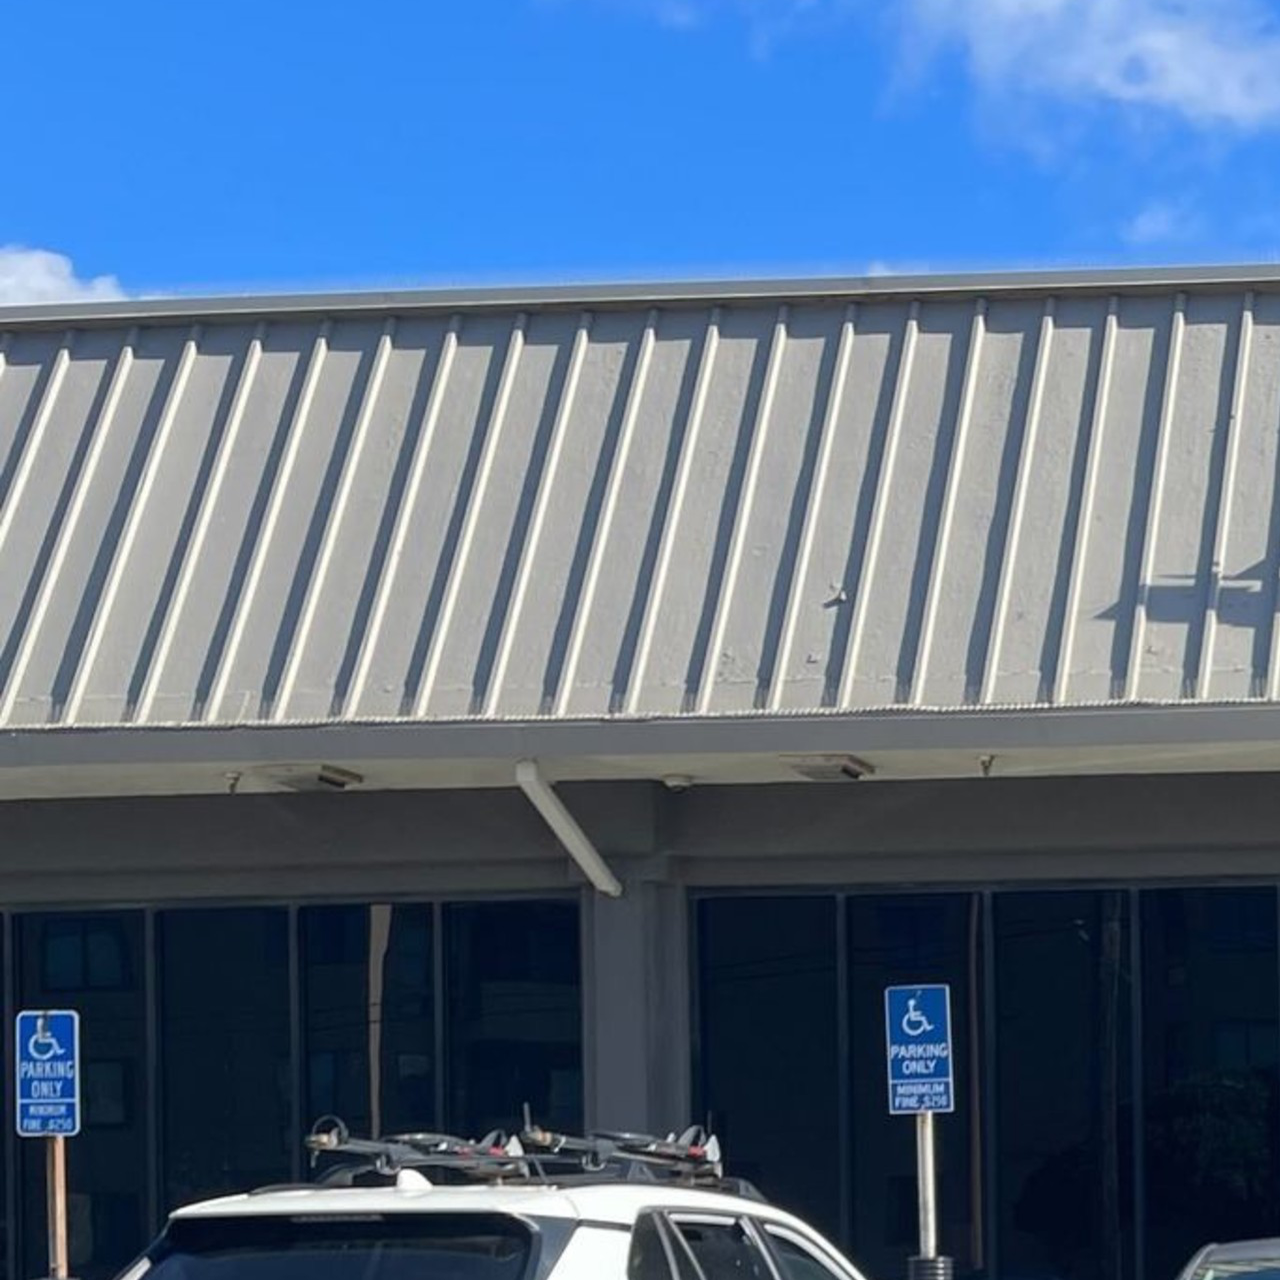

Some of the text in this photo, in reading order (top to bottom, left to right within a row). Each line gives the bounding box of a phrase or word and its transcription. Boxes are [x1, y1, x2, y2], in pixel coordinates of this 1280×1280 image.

[890, 1042, 948, 1059] PARKING
[20, 1061, 74, 1079] PARKING
[902, 1059, 936, 1074] ONLY
[31, 1080, 62, 1098] ONLY
[896, 1083, 945, 1095] MINIMUM
[895, 1096, 918, 1108] FINE
